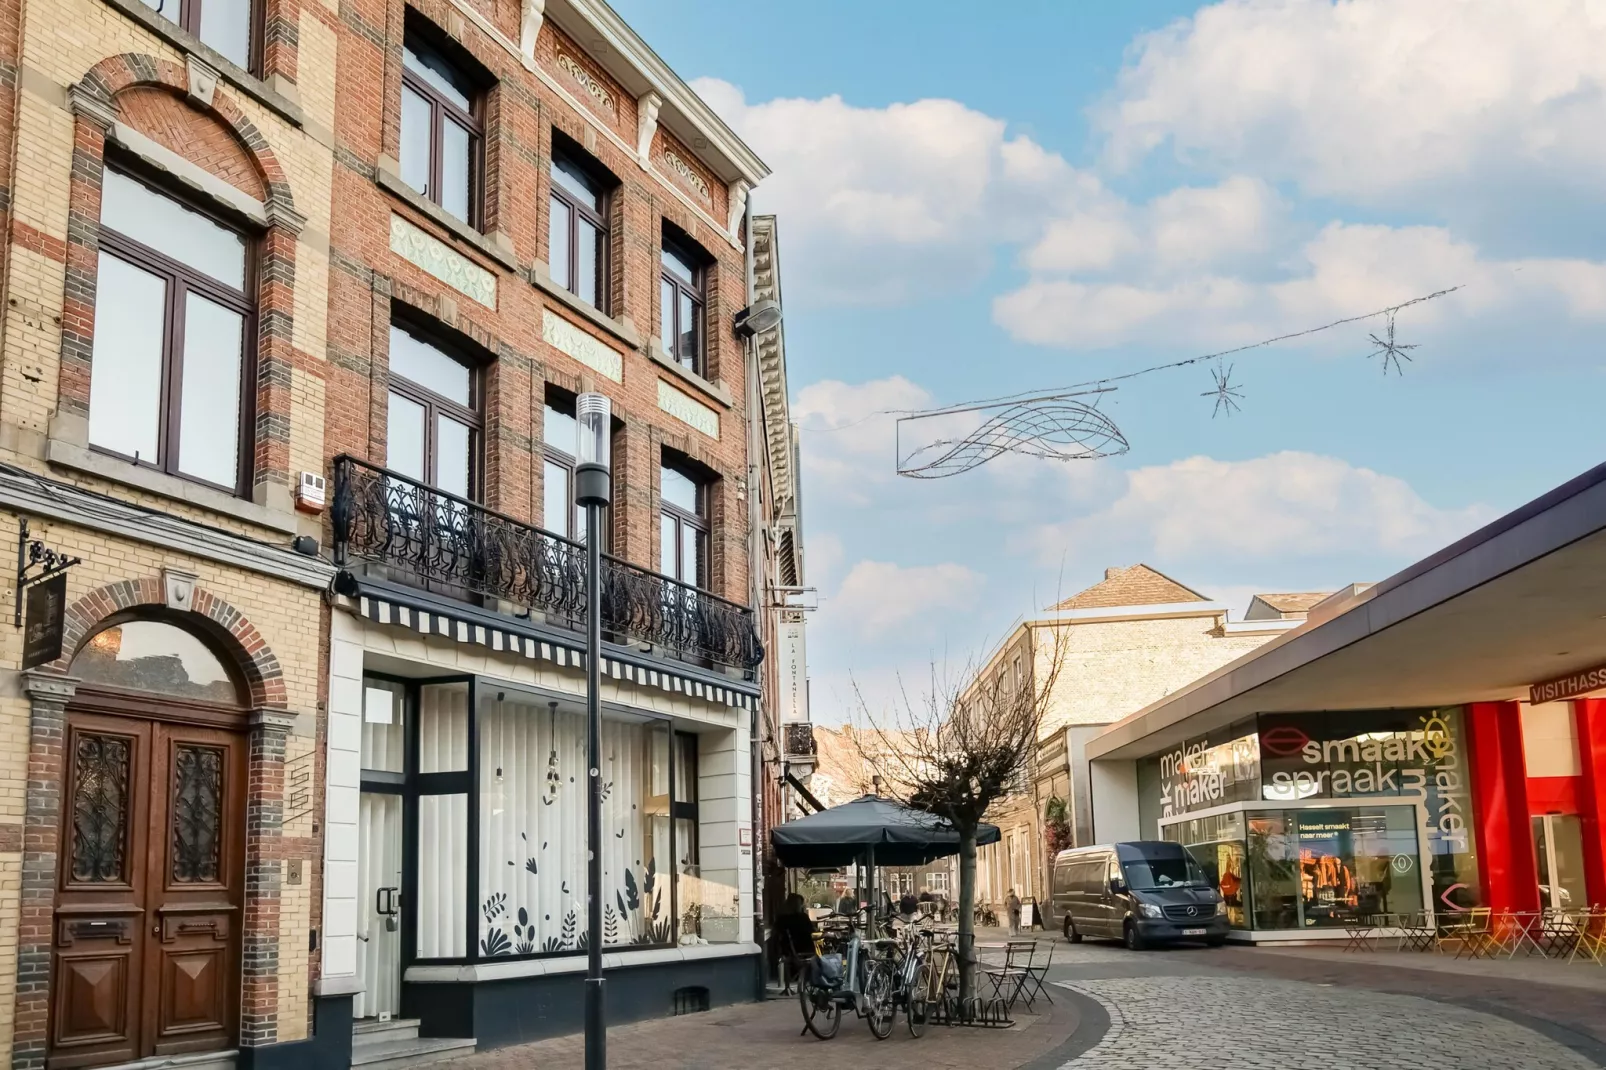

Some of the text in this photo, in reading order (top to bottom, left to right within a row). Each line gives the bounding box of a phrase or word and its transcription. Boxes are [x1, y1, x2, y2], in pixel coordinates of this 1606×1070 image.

[1532, 668, 1606, 702] VISITHASS
[1160, 740, 1208, 779] maker
[1302, 731, 1430, 763] smaak
[1174, 770, 1227, 808] maker
[1272, 762, 1398, 798] spraak
